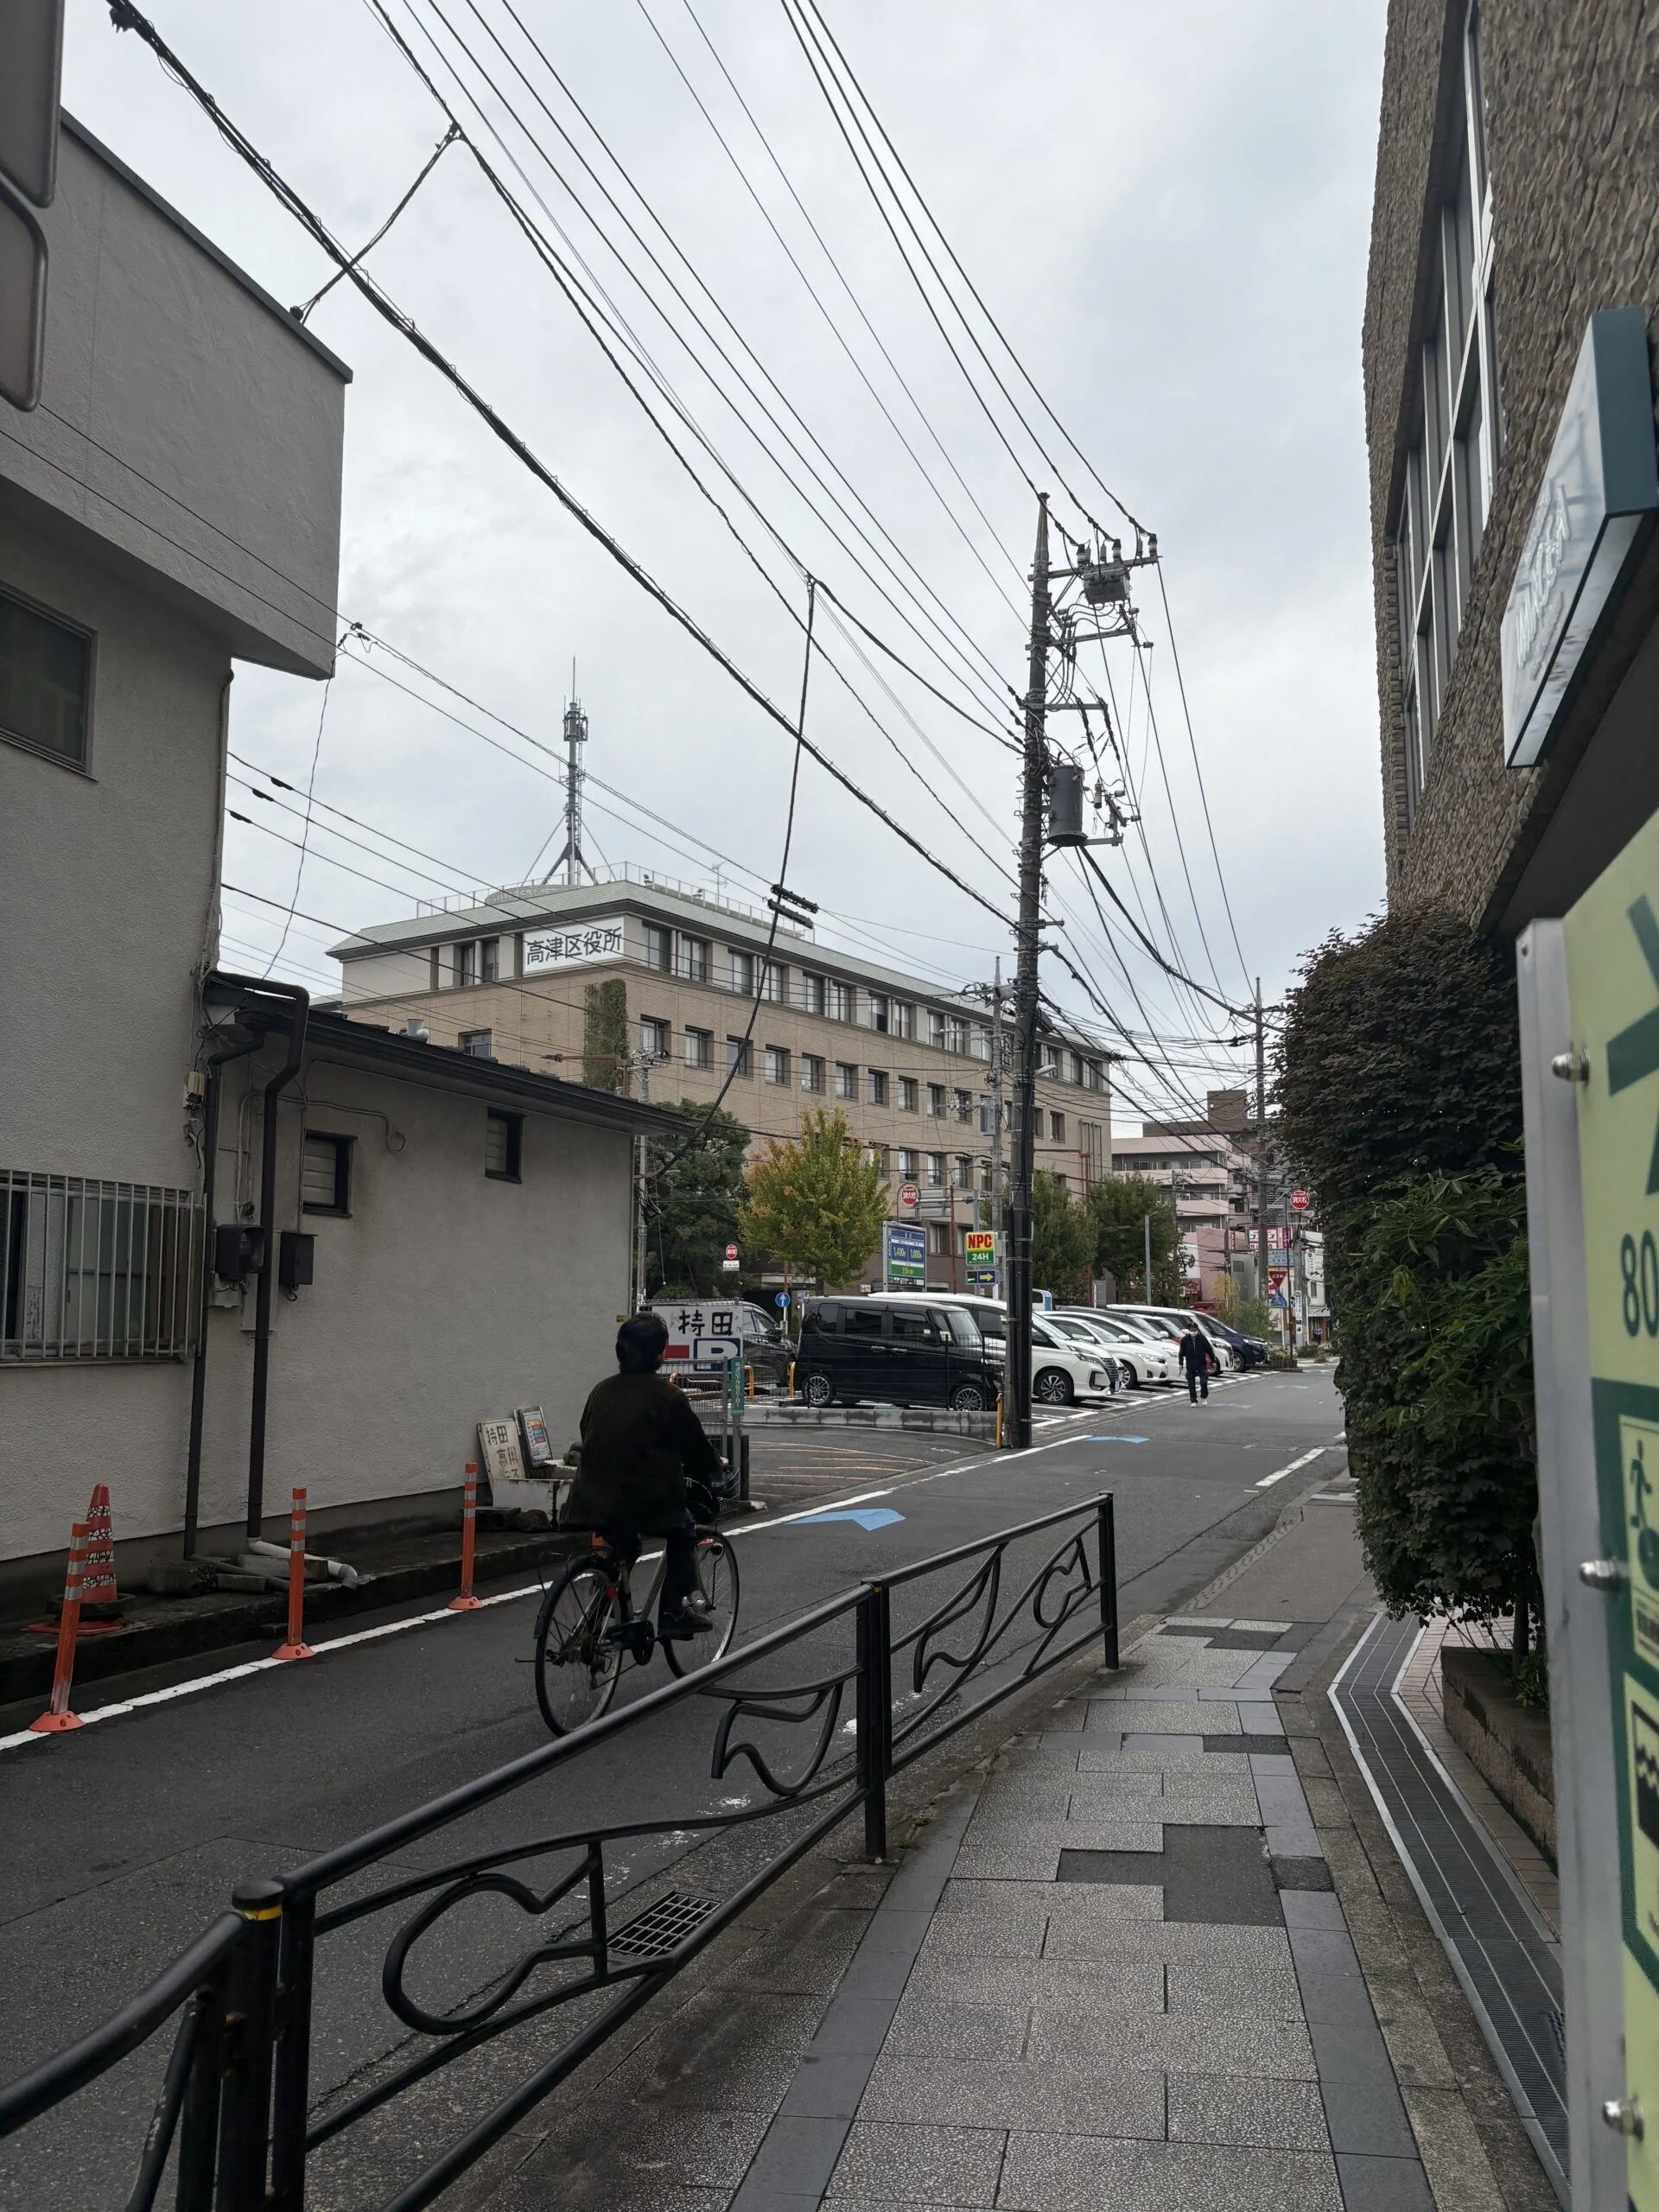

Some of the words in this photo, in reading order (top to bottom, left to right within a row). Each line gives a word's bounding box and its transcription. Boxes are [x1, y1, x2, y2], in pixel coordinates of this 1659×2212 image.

[527, 926, 622, 965] 高津区役所
[968, 1234, 993, 1249] NPC
[971, 1252, 989, 1261] 24H
[677, 1309, 734, 1337] 持田
